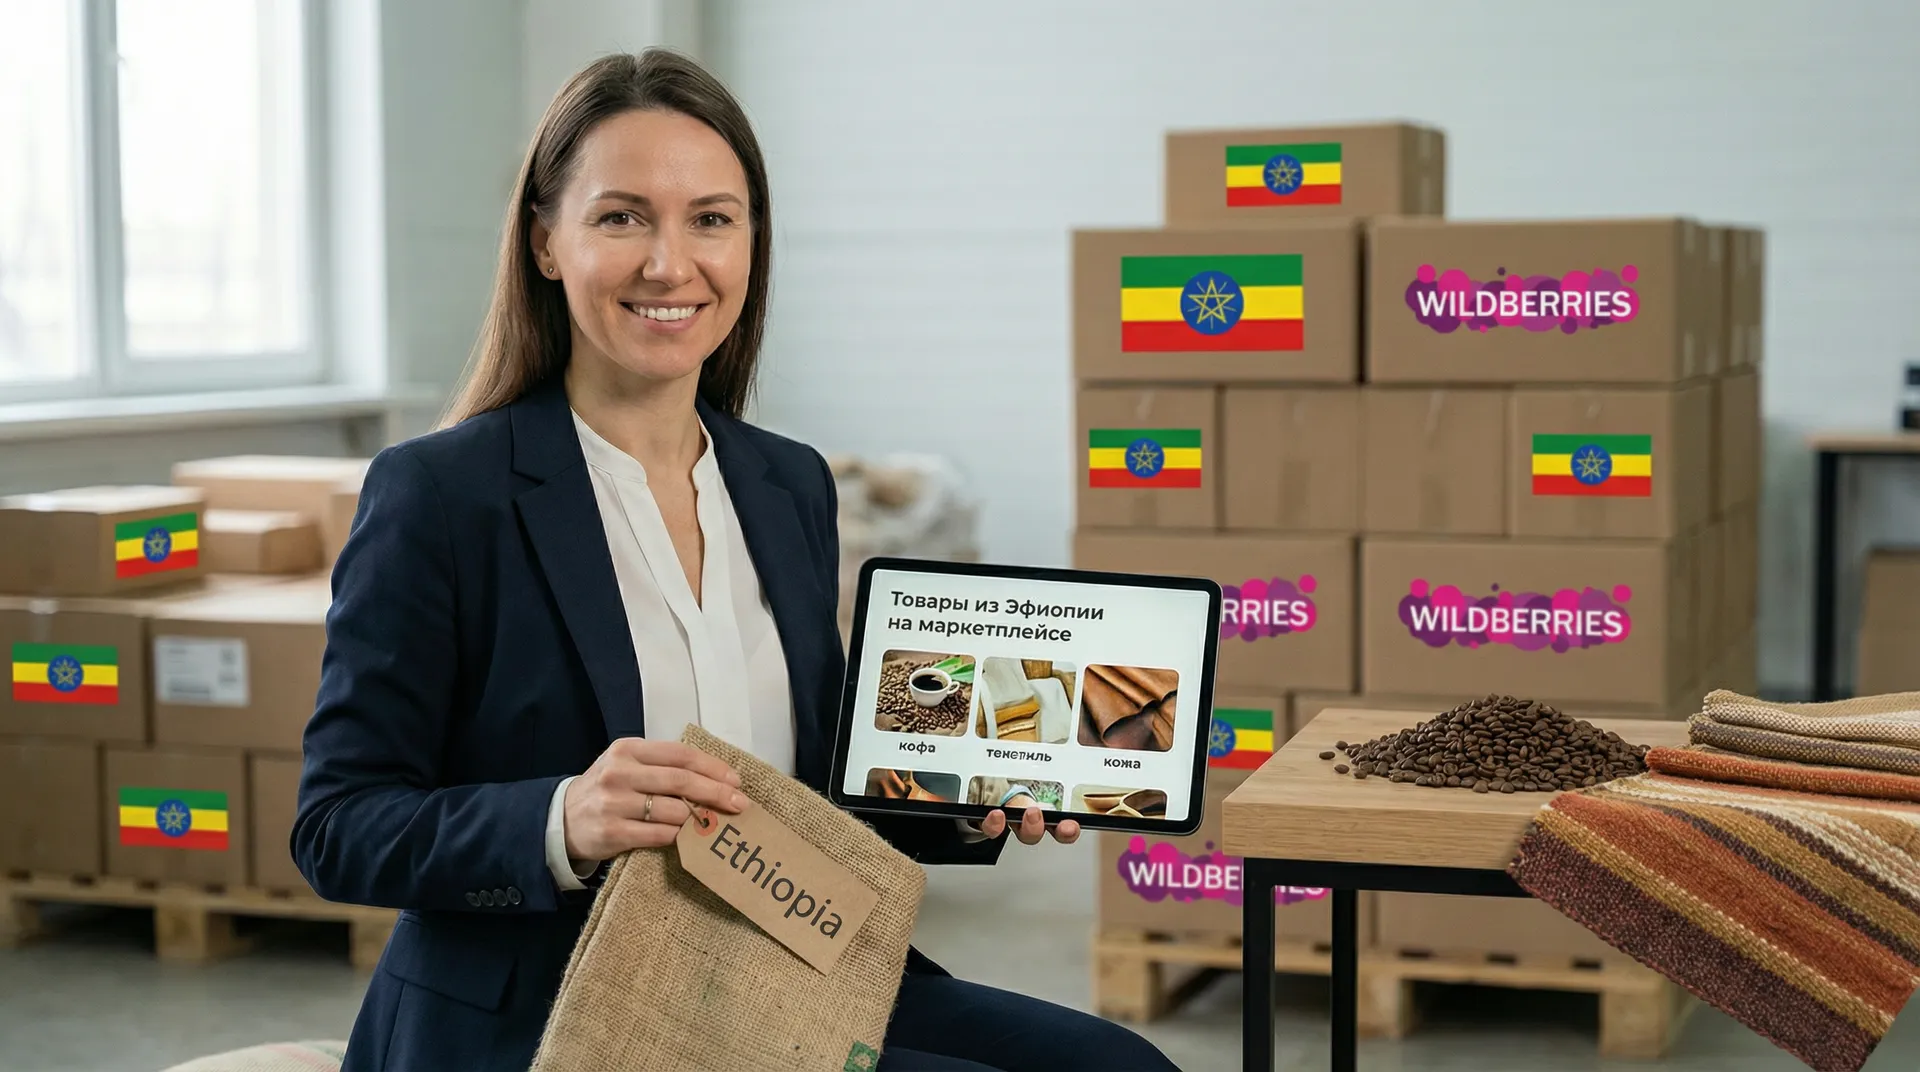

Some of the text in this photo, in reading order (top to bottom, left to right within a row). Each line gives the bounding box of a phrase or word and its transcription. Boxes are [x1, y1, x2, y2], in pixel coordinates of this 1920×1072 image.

[1416, 290, 1632, 317] WILDBERRIES
[891, 591, 1104, 620] Товары из Эфиопии
[1221, 599, 1309, 627] RRIES
[888, 617, 1072, 641] на маркетплейсе
[1410, 605, 1623, 637] WILDBERRIES
[709, 823, 843, 939] Ethiopia
